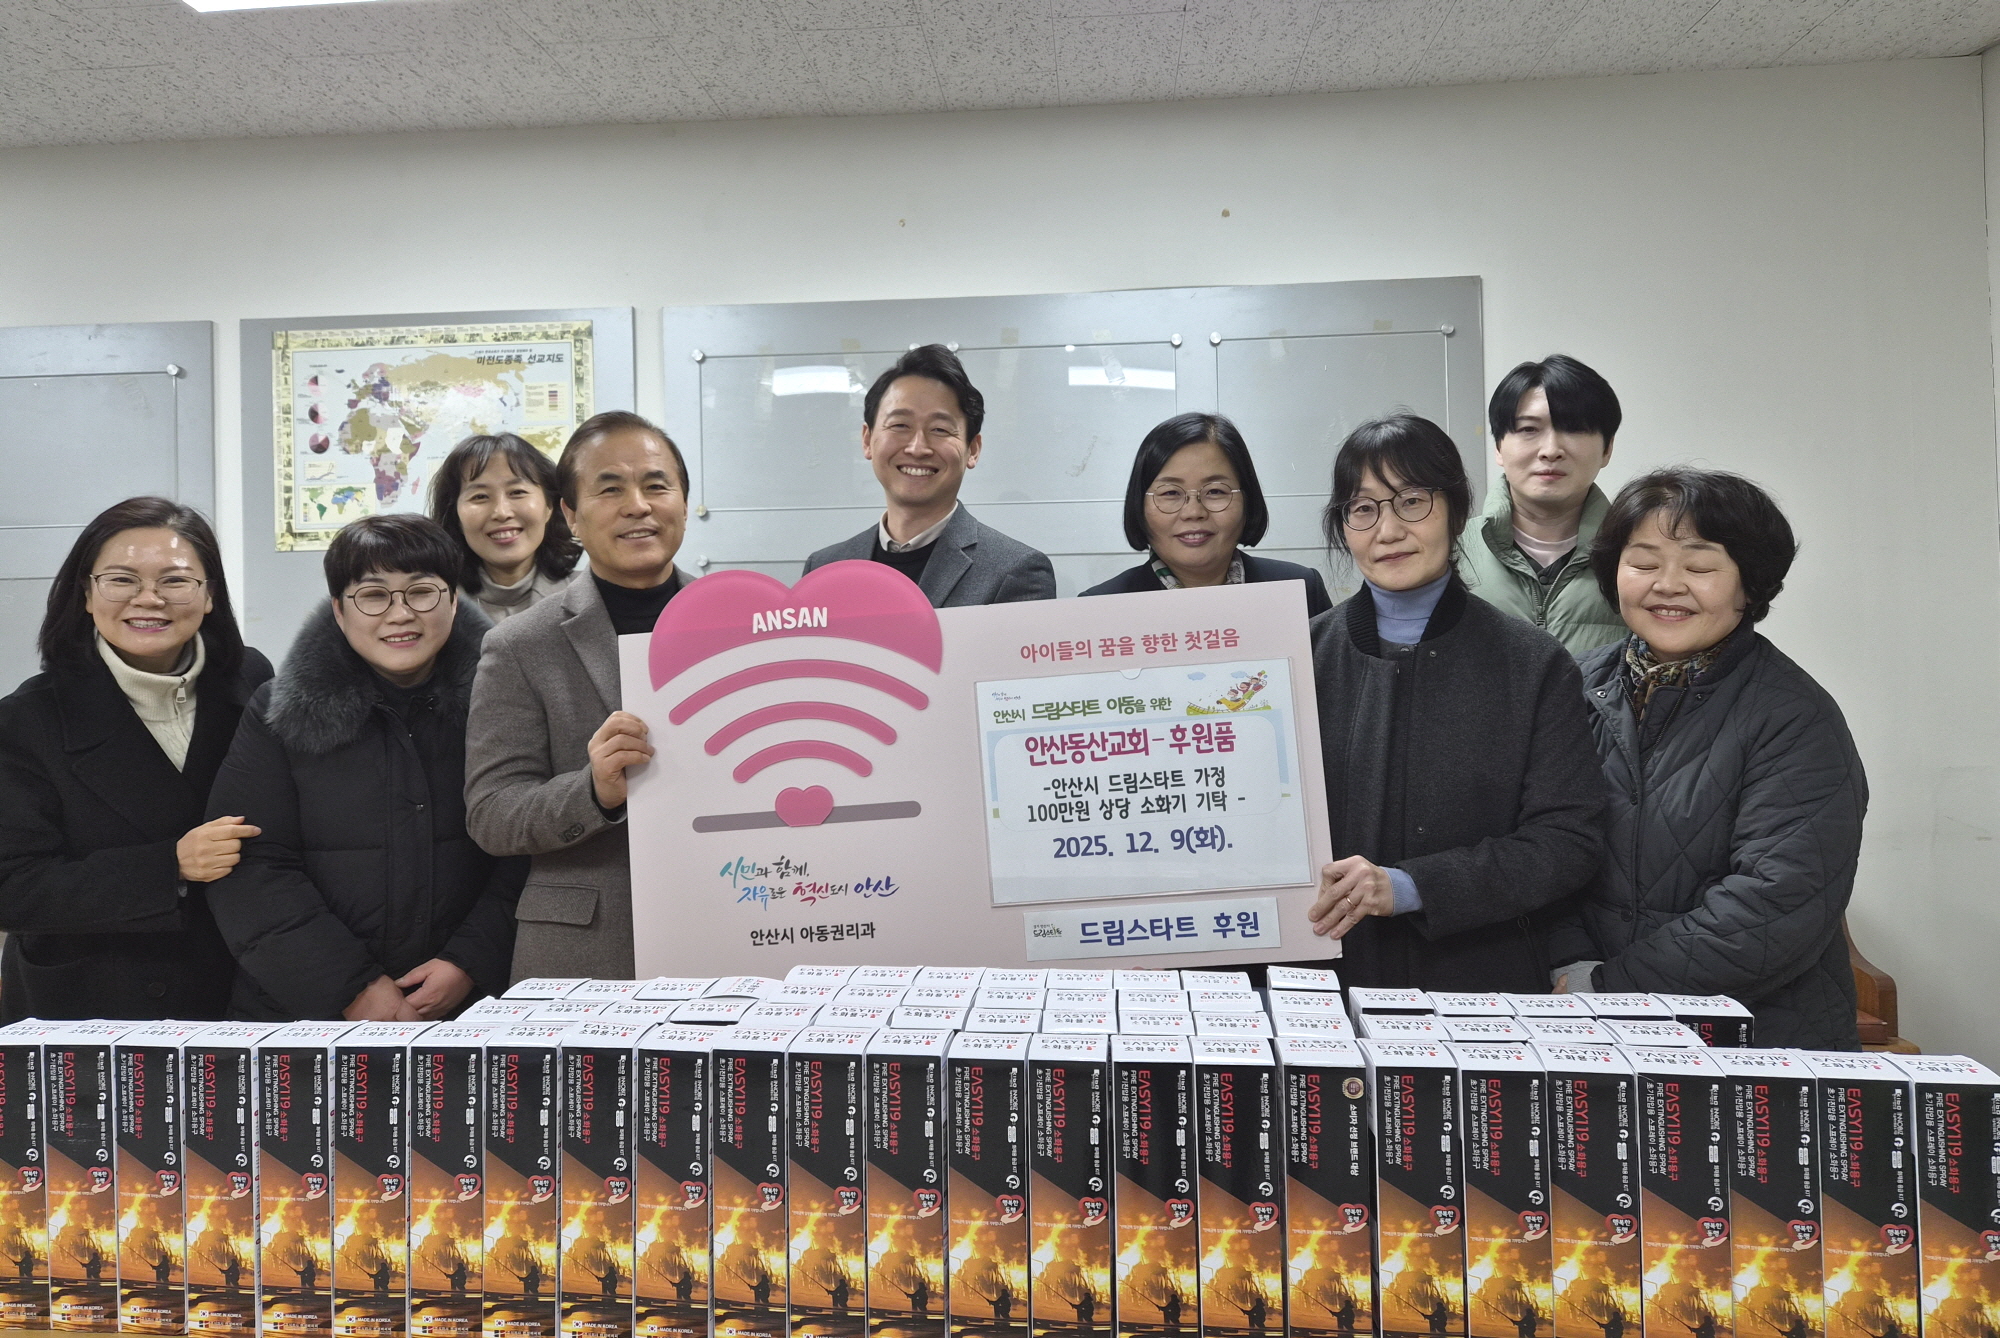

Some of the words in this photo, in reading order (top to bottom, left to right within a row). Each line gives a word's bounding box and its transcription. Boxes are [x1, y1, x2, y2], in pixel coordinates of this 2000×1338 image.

[477, 355, 522, 365] 미전도종족
[528, 354, 564, 364] 선교지도
[752, 606, 828, 634] ANSAN
[1020, 640, 1092, 663] 아이들의
[1099, 636, 1134, 657] 꿈을
[1141, 633, 1178, 653] 향한
[1185, 628, 1240, 650] 첫걸음
[993, 709, 1025, 724] 안산시
[1032, 699, 1102, 720] 드림스타트
[1150, 697, 1172, 711] 위한
[1169, 721, 1236, 753] 후원품
[1109, 770, 1185, 794] 드림스타트
[1195, 766, 1225, 788] 가정
[1028, 800, 1090, 823] 100만원
[1099, 798, 1130, 820] 상당
[1141, 794, 1186, 814] 소화기
[1196, 791, 1227, 812] 기탁
[1053, 835, 1114, 858] 2025.
[1126, 831, 1159, 853] 12.
[1171, 824, 1233, 854] 9(화).
[719, 856, 772, 888] 시민과
[737, 885, 787, 911] 자유로운
[792, 882, 848, 907] 혁신도시
[854, 875, 900, 898] 안산
[750, 927, 794, 946] 안산시
[800, 922, 876, 943] 아동권리과
[1080, 916, 1198, 946] 드림스타트
[1213, 911, 1260, 939] 후원
[1220, 1072, 1234, 1132] EASY119
[1308, 1074, 1322, 1133] EASY119
[1349, 1104, 1358, 1124] 소비자
[1402, 1076, 1416, 1134] EASY119
[1488, 1080, 1502, 1139] EASY119
[1574, 1080, 1590, 1141] EASY119
[1666, 1082, 1682, 1143] EASY119
[1756, 1086, 1770, 1146] EASY119
[1848, 1088, 1864, 1150] EASY119
[1350, 1125, 1358, 1138] 선정
[1566, 1096, 1574, 1148] EXTINGUISHING
[1746, 1101, 1754, 1154] EXTINGUISHING
[1838, 1104, 1847, 1157] EXTINGUISHING
[1936, 1109, 1945, 1163] EXTINGUISHING
[1946, 1094, 1962, 1156] EASY119
[1222, 1134, 1232, 1168] 소화용구
[1308, 1135, 1318, 1168] 소화용구
[1350, 1140, 1359, 1161] 브랜드
[1402, 1136, 1412, 1170] 소화용구
[1490, 1141, 1500, 1176] 소화용구
[1557, 1143, 1565, 1170] 소화용구
[1576, 1143, 1586, 1178] 소화용구
[1668, 1145, 1678, 1180] 소화용구
[1736, 1149, 1745, 1176] 소화용구
[1758, 1148, 1768, 1184] 소화용구
[1829, 1152, 1838, 1180] 소화용구
[1350, 1163, 1359, 1176] 대상
[1850, 1152, 1860, 1188] 소화용구
[1927, 1158, 1936, 1186] 소화용구
[1950, 1158, 1960, 1194] 소화용구
